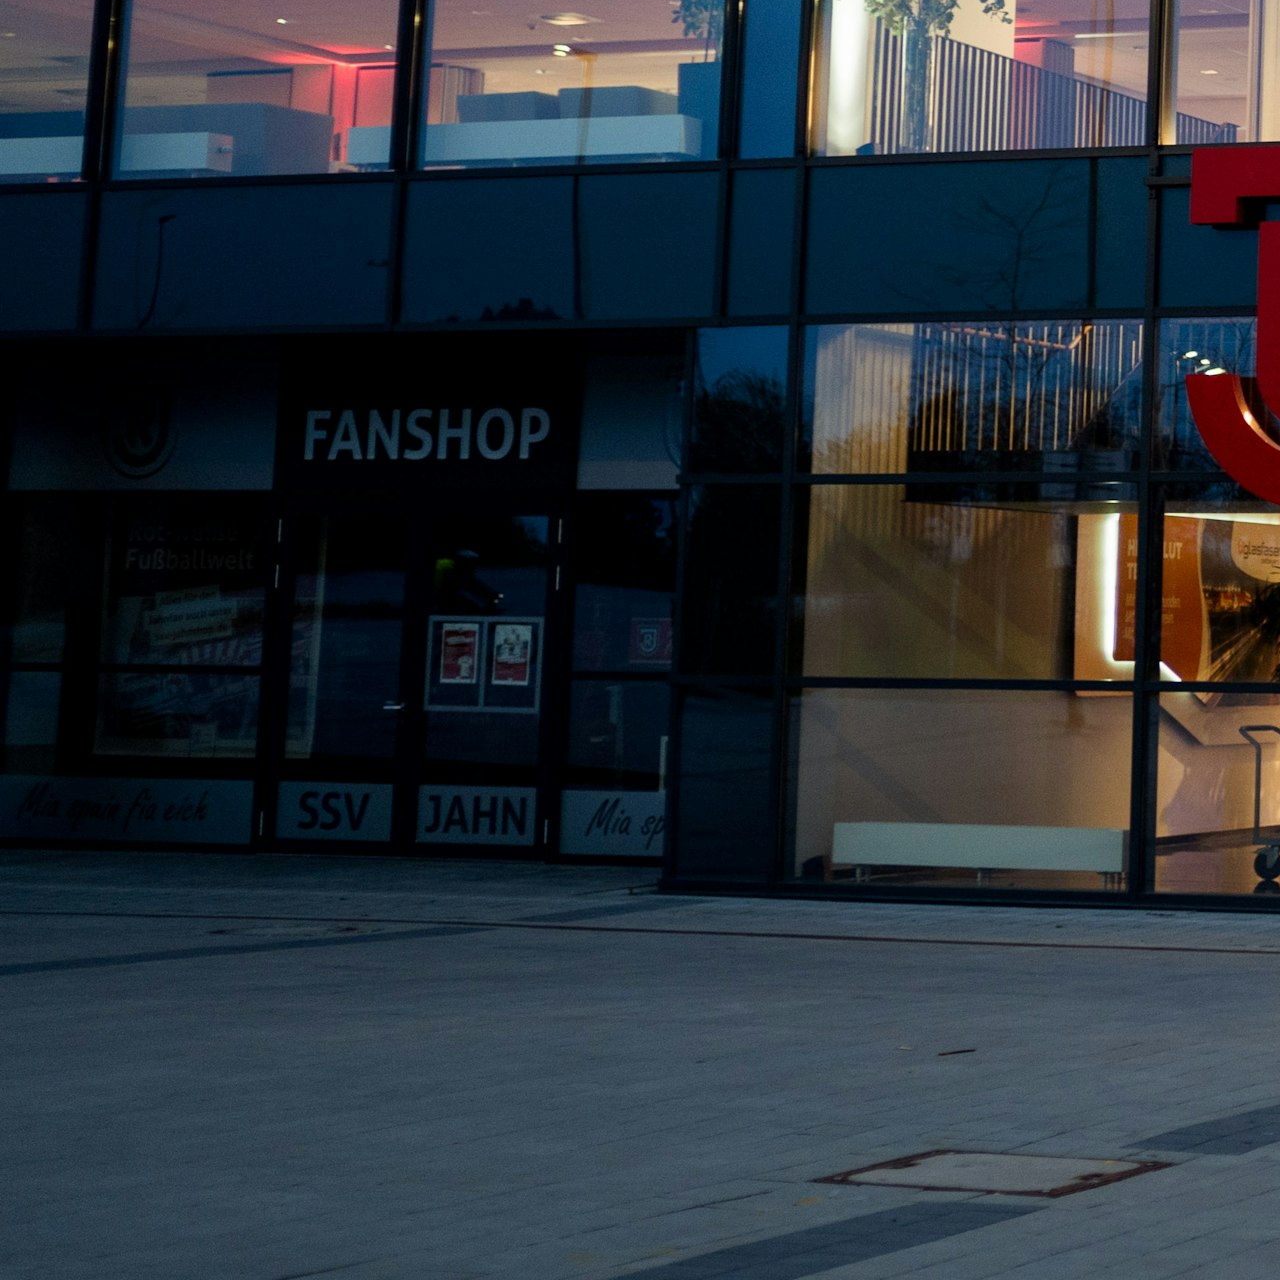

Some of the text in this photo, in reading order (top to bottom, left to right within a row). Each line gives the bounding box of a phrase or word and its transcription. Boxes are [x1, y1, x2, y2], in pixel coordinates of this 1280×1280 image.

[302, 406, 552, 462] FANSHOP
[124, 547, 256, 570] Fußballwelt
[16, 782, 60, 820] Mia
[298, 791, 371, 831] SSV
[424, 794, 527, 837] JAHN
[584, 797, 632, 837] Mia
